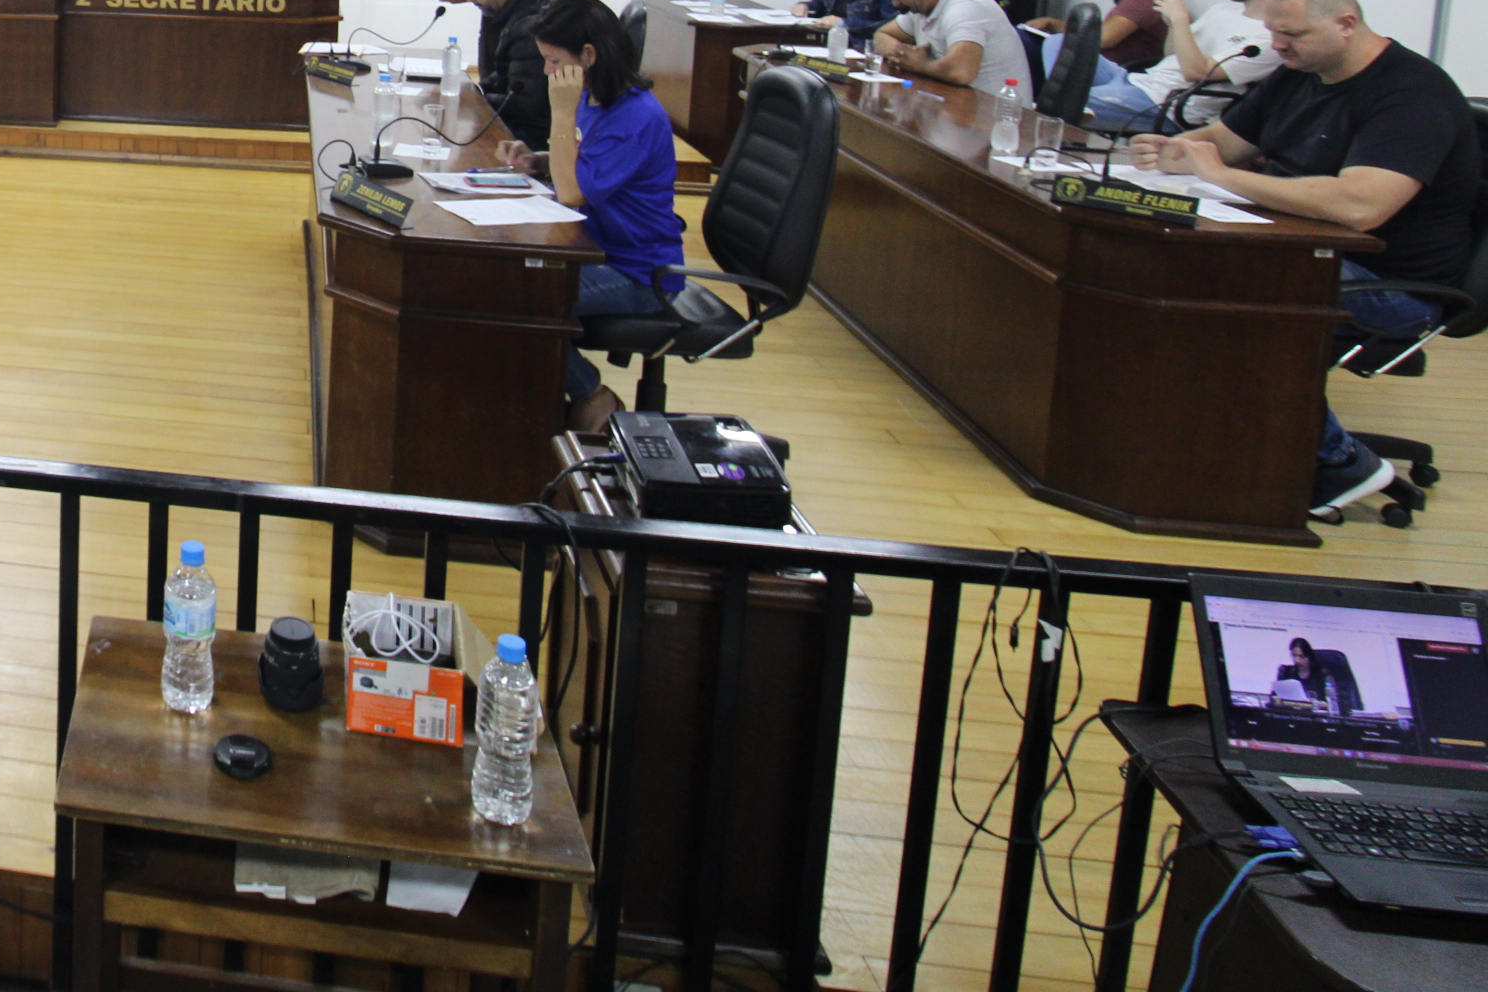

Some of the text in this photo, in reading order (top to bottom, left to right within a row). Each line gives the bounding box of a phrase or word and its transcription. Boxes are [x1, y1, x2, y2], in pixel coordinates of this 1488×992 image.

[381, 195, 406, 212] LEMOS
[1094, 186, 1142, 204] ANDRÉ
[1142, 193, 1194, 212] FLENIK
